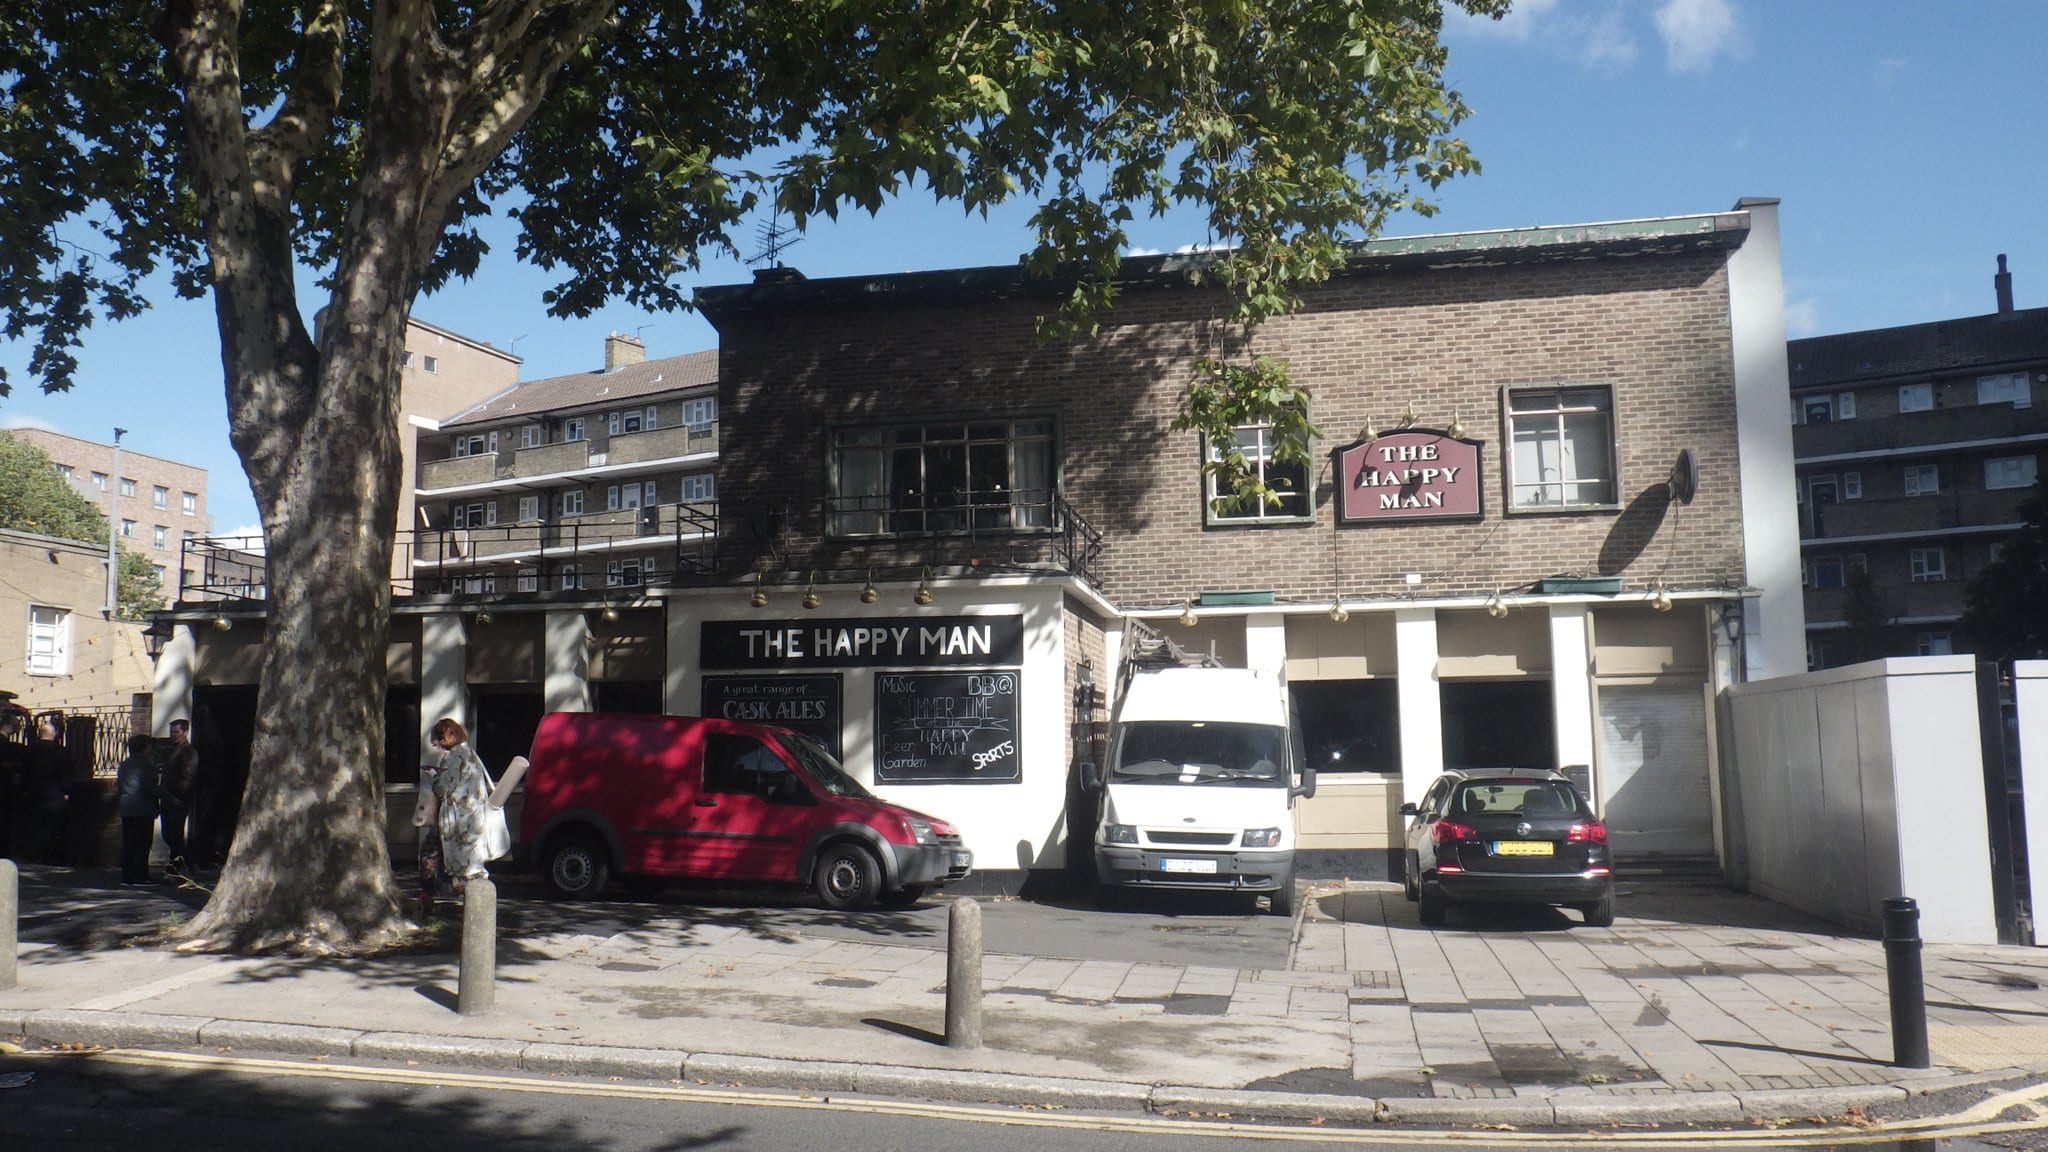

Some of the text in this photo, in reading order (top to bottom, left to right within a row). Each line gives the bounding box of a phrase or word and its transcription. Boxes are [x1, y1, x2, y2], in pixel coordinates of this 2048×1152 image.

[1378, 444, 1439, 463] THE
[1361, 466, 1460, 487] HAPPY
[1379, 491, 1444, 510] MAN
[739, 625, 991, 658] THE HAPPY MAN
[723, 685, 730, 694] A
[732, 684, 759, 695] great
[763, 685, 795, 695] range
[967, 675, 1014, 695] BBQ
[723, 700, 826, 719] CASK ALES
[898, 696, 995, 718] SUMMER TIME
[920, 729, 975, 742] HAPPY
[882, 751, 927, 770] Garden
[972, 740, 1014, 770] SPORTS
